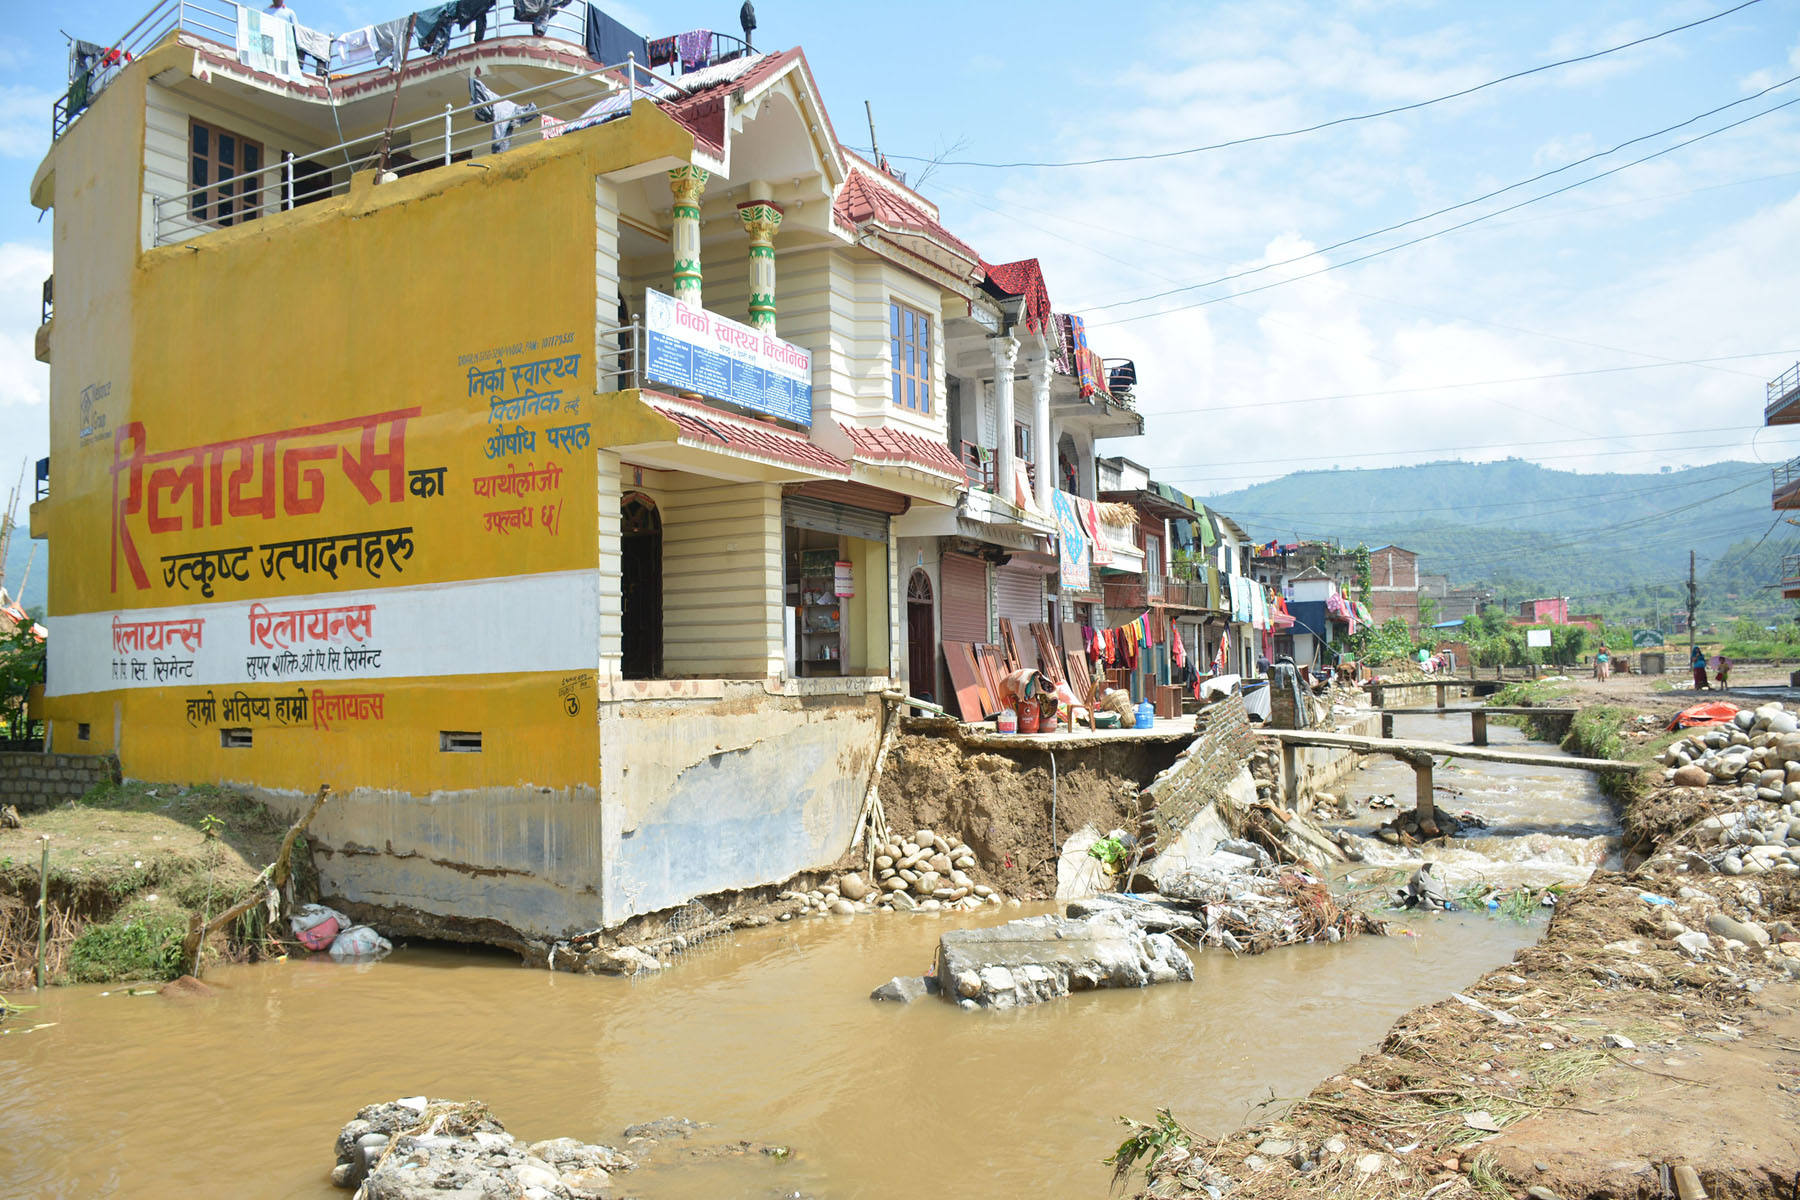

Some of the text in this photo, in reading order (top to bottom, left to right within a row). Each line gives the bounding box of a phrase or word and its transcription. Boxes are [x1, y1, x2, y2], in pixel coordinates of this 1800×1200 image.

[676, 302, 709, 336] निको
[714, 322, 759, 353] स्वास्थ्य
[763, 335, 808, 370] क्लिनिक
[467, 359, 506, 397] निको
[510, 354, 581, 394] स्वास्थ्य
[488, 388, 563, 424] क्लिनिक
[546, 423, 591, 454] पसल
[109, 406, 448, 593] रिलायन्स का
[160, 546, 254, 599] उत्कृष्ट
[112, 615, 206, 654] रिलायन्स
[248, 602, 377, 650] रिलायन्स
[153, 655, 194, 682] सिमेन्ट
[247, 656, 271, 680] सुपर
[343, 644, 382, 672] सिमेन्ट
[186, 688, 385, 732] हाम्रो भविष्य हाम्रो रिलायन्स
